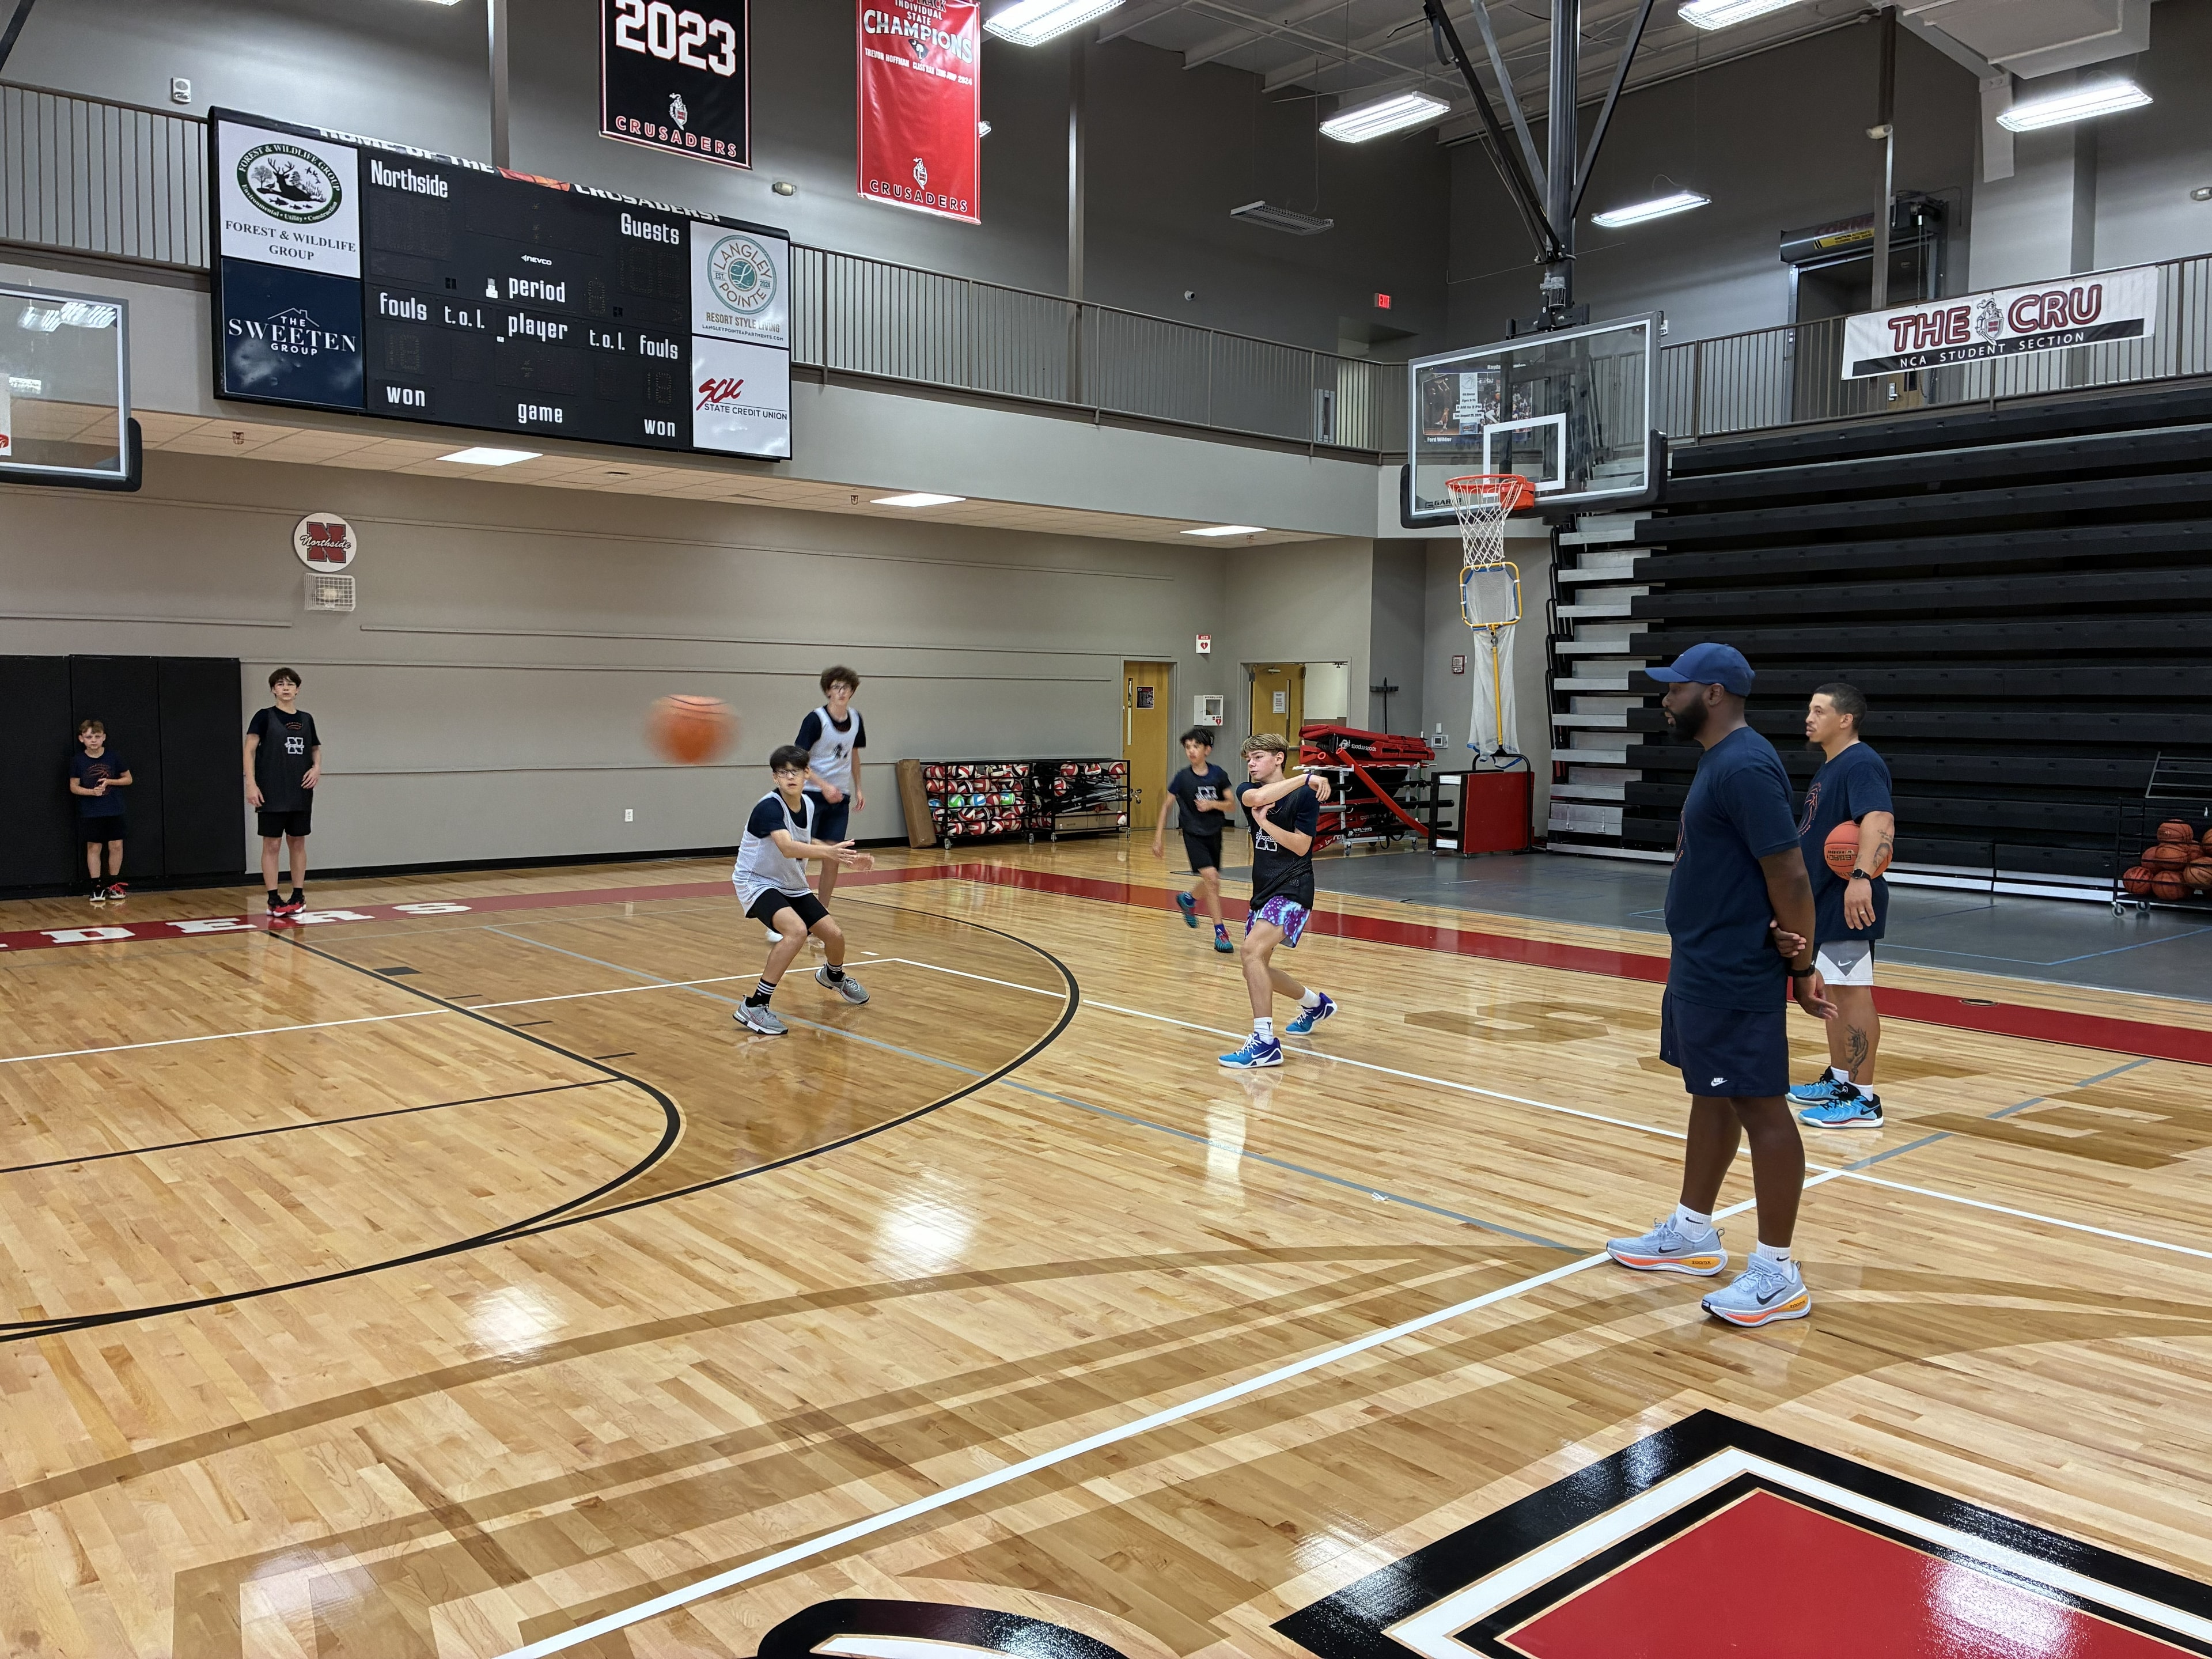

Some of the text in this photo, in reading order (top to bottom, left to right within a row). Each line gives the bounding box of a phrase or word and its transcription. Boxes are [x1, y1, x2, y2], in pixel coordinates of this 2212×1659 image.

[895, 0, 942, 20] INDIVIDUAL
[907, 12, 931, 26] STATE
[615, 0, 737, 78] 2023
[863, 9, 973, 64] CHAMPIONS
[865, 48, 884, 60] TREVOR
[886, 54, 910, 67] HOFFMAN
[615, 115, 737, 157] CRUSADERS
[239, 145, 340, 191] FOREST & WILDLIFE GROUP
[370, 160, 448, 198] Northside
[242, 184, 279, 217] Environmental
[284, 214, 303, 222] Utility
[870, 180, 968, 212] CRUSADERS
[225, 220, 356, 252] FOREST & WILDLIFE
[620, 213, 680, 245] Guests
[269, 245, 315, 260] GROUP
[714, 243, 772, 279] LANGLEY
[509, 276, 566, 303] period
[719, 282, 767, 308] POINTE
[281, 316, 305, 327] THE
[380, 292, 427, 321] fouls
[508, 312, 568, 342] player
[640, 334, 678, 360] fouls
[706, 312, 780, 333] RESORT STYLE LIVING
[1888, 284, 2103, 353] THE CRU
[229, 319, 356, 353] SWEETEN
[702, 324, 783, 341] LANGLEYPOINTEAPARTMENTS.COM
[271, 343, 317, 355] GROUP
[1900, 332, 2084, 369] NCA STUDENT SECTION
[386, 386, 426, 407] won
[518, 403, 563, 424] game
[704, 403, 787, 421] STATE CREDIT UNION
[644, 418, 676, 437] won
[300, 534, 351, 549] Northside
